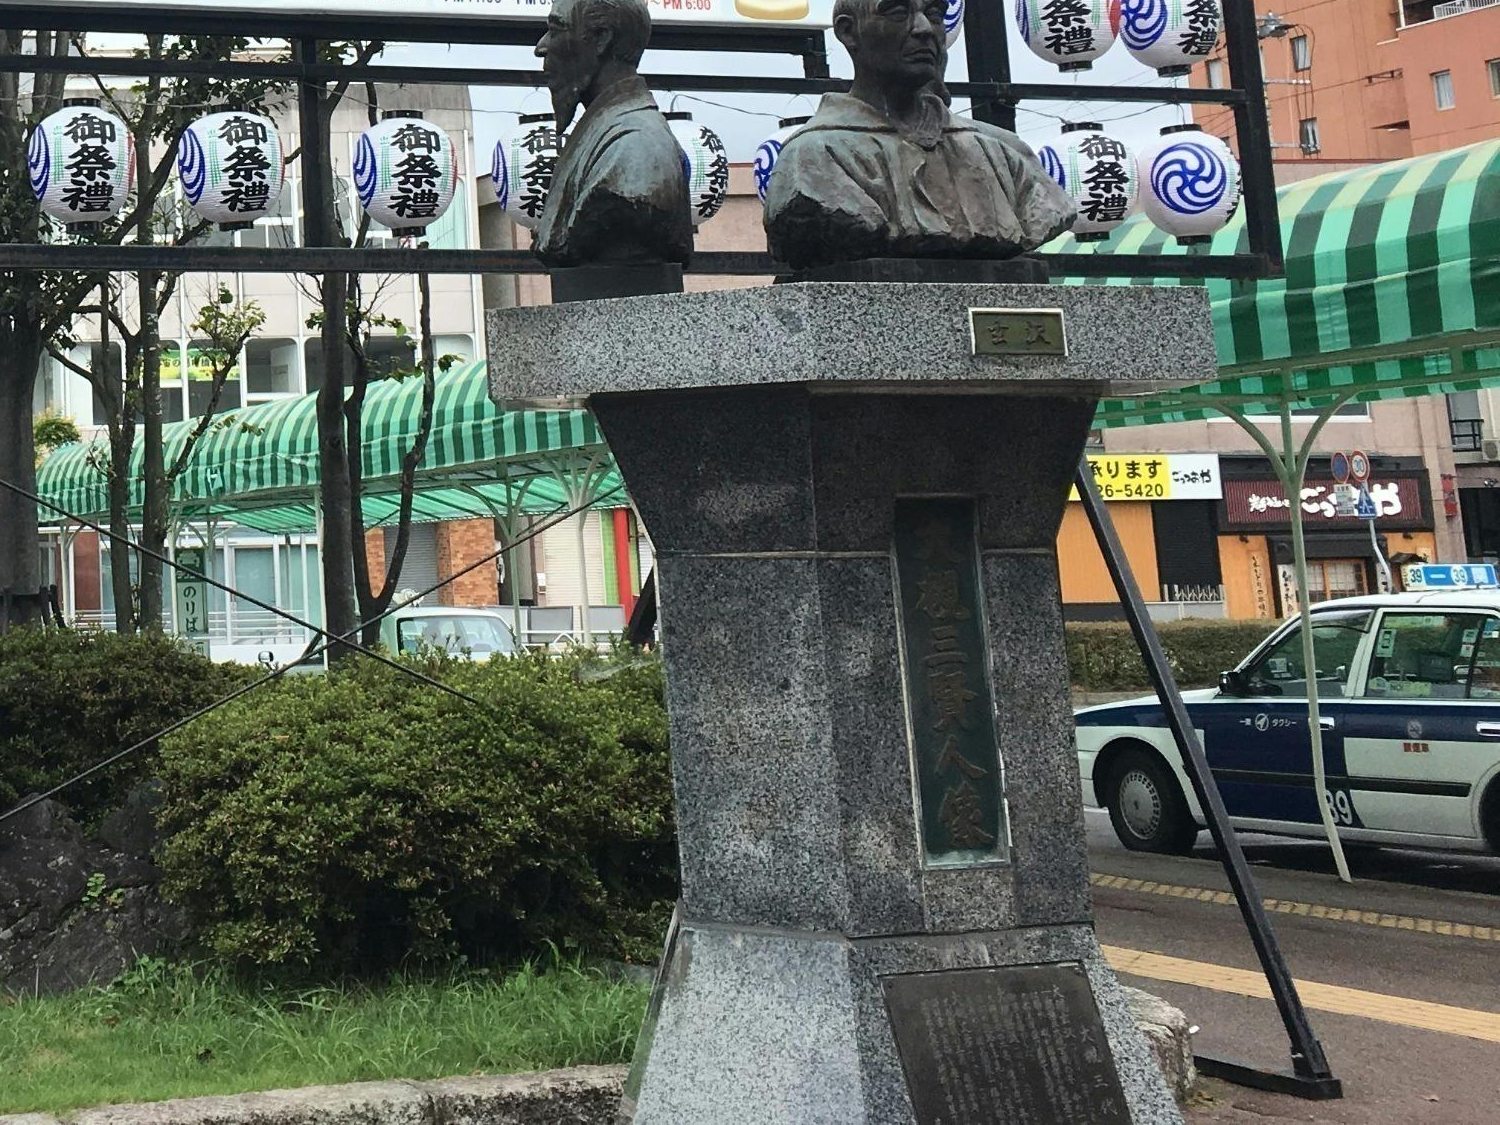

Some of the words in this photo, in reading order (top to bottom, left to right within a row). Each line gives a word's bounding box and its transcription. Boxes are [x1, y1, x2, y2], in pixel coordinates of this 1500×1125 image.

[62, 107, 117, 213] 御祭禮
[215, 110, 270, 212] 御祭禮
[386, 119, 441, 219] 御祭禮
[1077, 133, 1128, 221] 御祭禮
[1354, 458, 1366, 473] 30
[1300, 482, 1402, 518] ごっや
[1409, 568, 1422, 583] 39
[1452, 569, 1466, 583] 39
[183, 585, 198, 632] のりば
